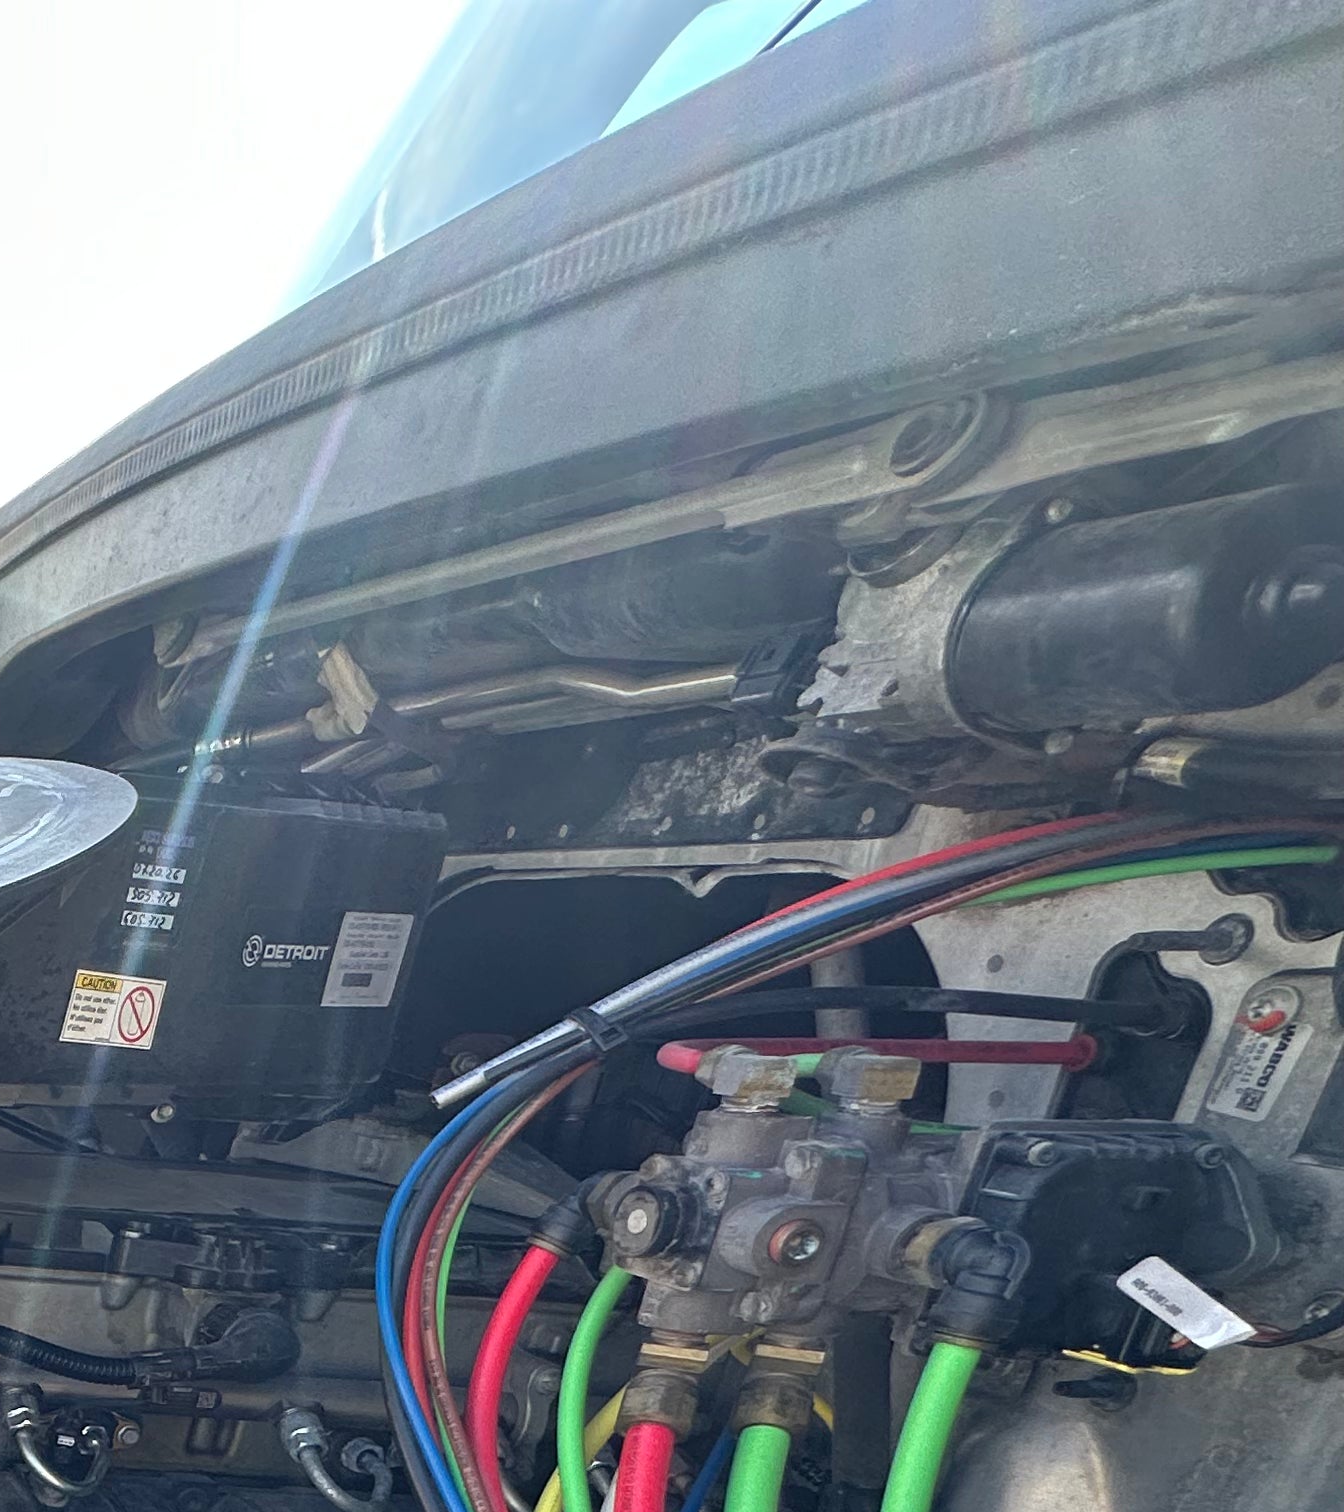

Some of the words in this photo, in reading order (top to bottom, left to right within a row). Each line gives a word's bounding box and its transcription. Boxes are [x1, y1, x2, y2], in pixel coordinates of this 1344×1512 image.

[263, 944, 331, 961] DETROIT
[81, 977, 117, 990] CAUTION
[1256, 1024, 1297, 1088] WABCO
